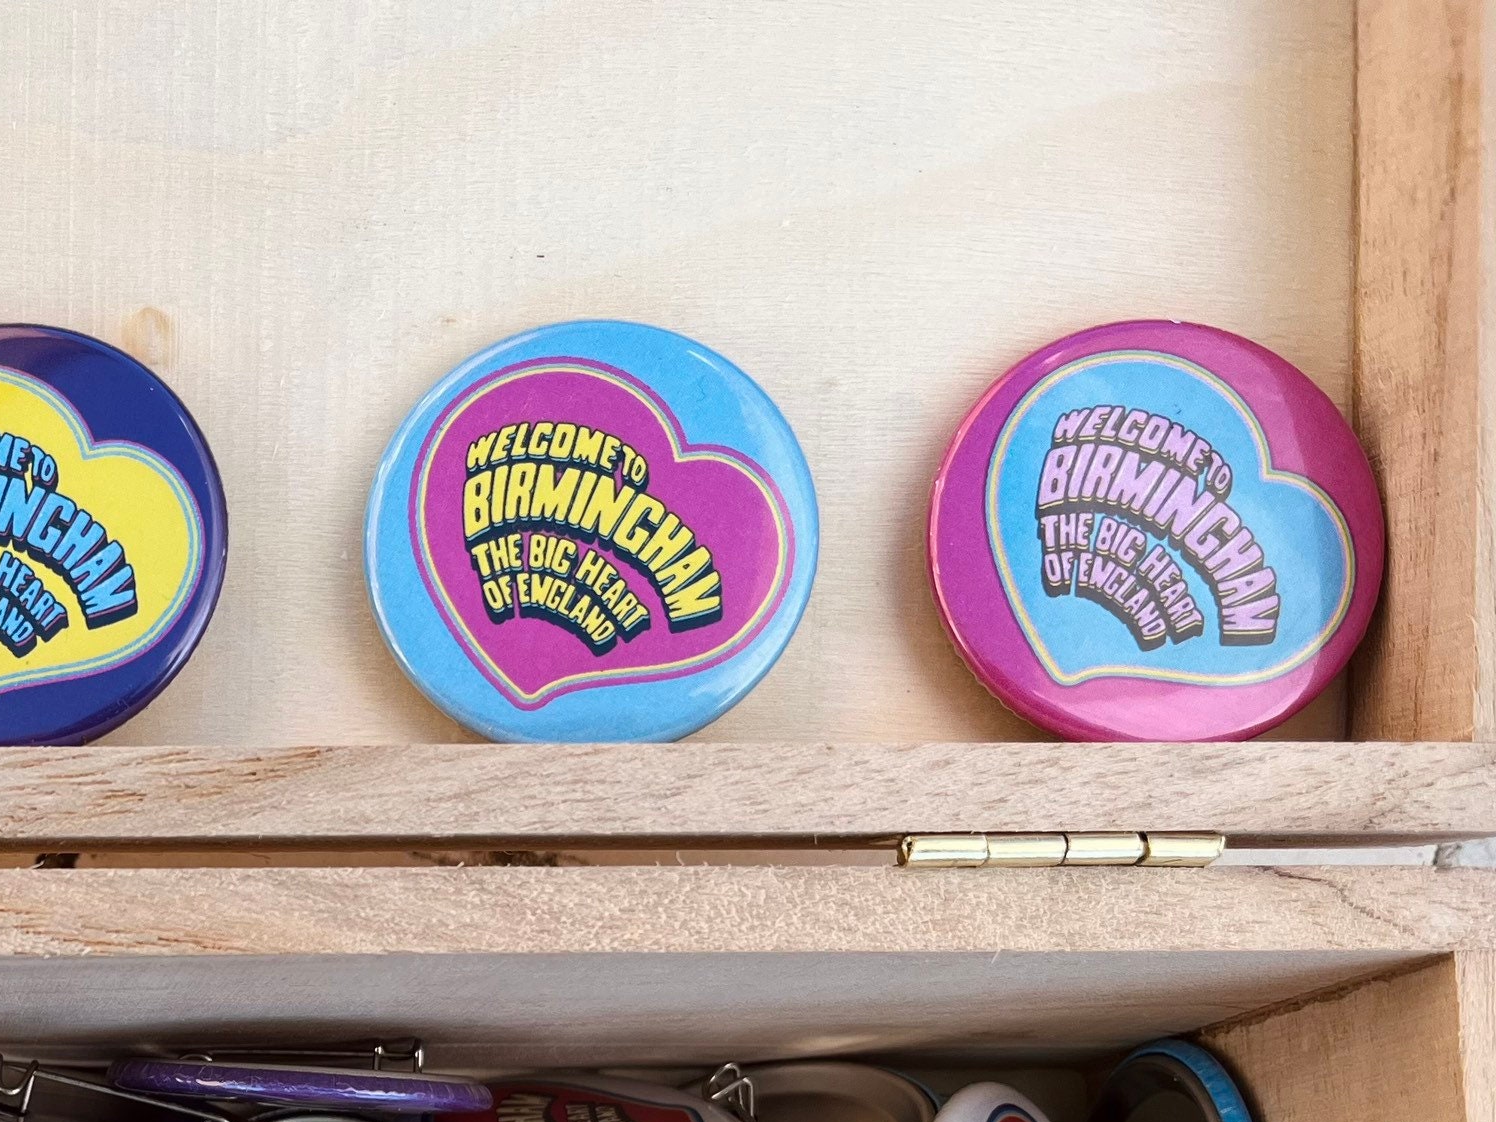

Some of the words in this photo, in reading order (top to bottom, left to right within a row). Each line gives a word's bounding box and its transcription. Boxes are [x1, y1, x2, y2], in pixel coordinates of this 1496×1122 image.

[30, 446, 54, 482] TO
[467, 422, 622, 470] WELCOME
[621, 446, 647, 484] TO
[1055, 406, 1211, 472] WELCOME
[1206, 452, 1231, 491] TO
[464, 463, 720, 619] BIRMINGHAM
[472, 534, 522, 577] THE
[529, 534, 577, 574] BIG
[575, 550, 649, 629] HEART
[1038, 444, 1279, 632] BIRMINGHAM
[1042, 513, 1093, 549] THE
[1095, 518, 1146, 565] BIG
[1138, 546, 1203, 630] HEART
[483, 576, 512, 610] OF
[516, 573, 615, 643] ENGLAND
[1044, 553, 1073, 584] OF
[1078, 552, 1166, 639] ENGLAND
